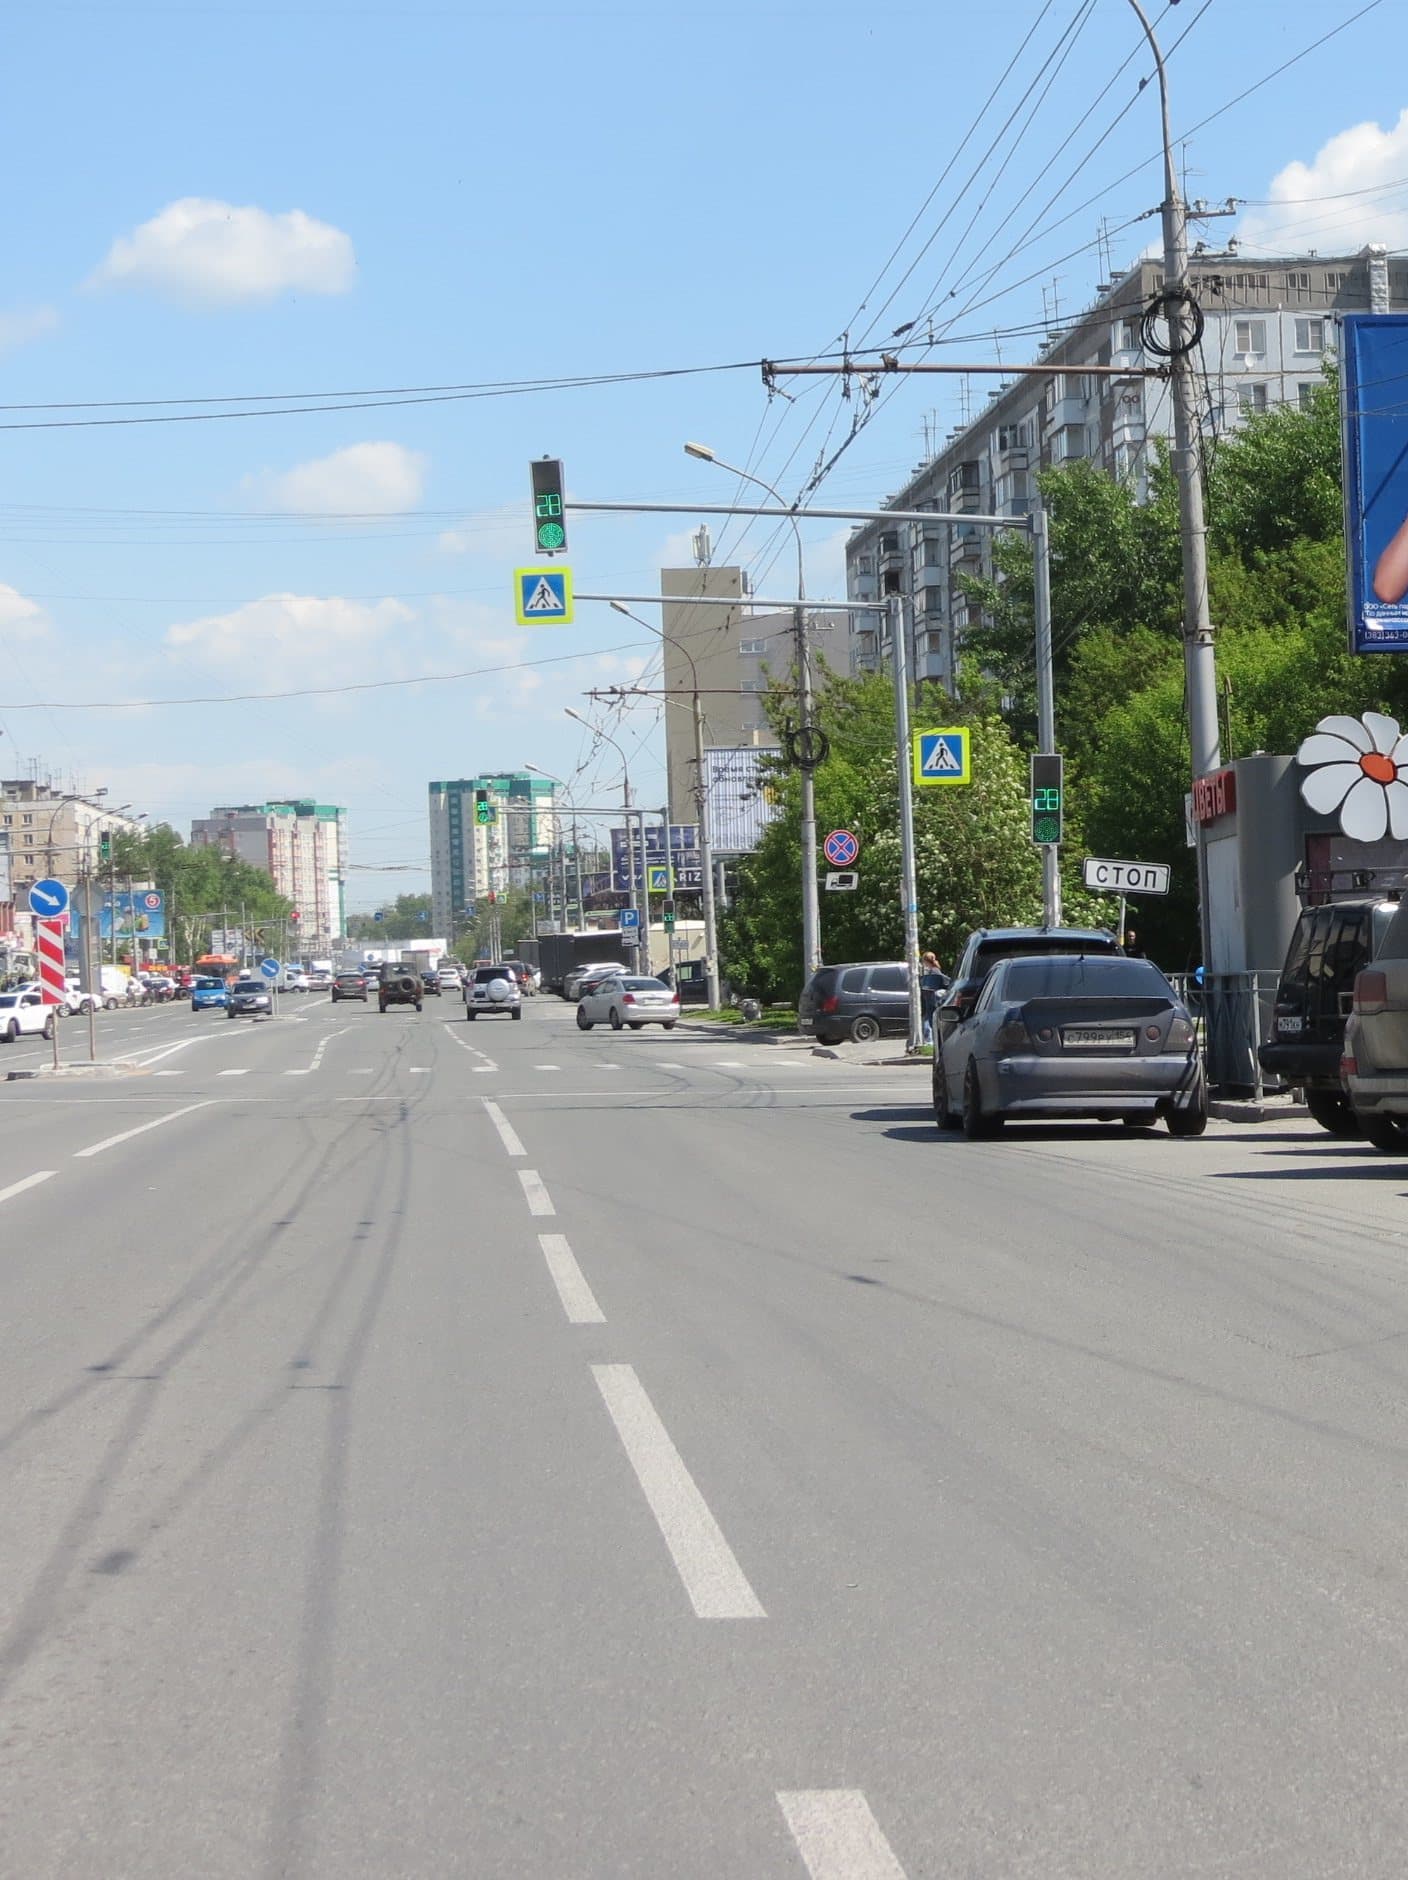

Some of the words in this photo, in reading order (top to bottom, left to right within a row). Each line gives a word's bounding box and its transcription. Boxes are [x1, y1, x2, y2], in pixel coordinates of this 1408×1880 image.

[536, 494, 561, 517] 28
[1034, 788, 1059, 810] 28
[1096, 865, 1157, 889] СТОП
